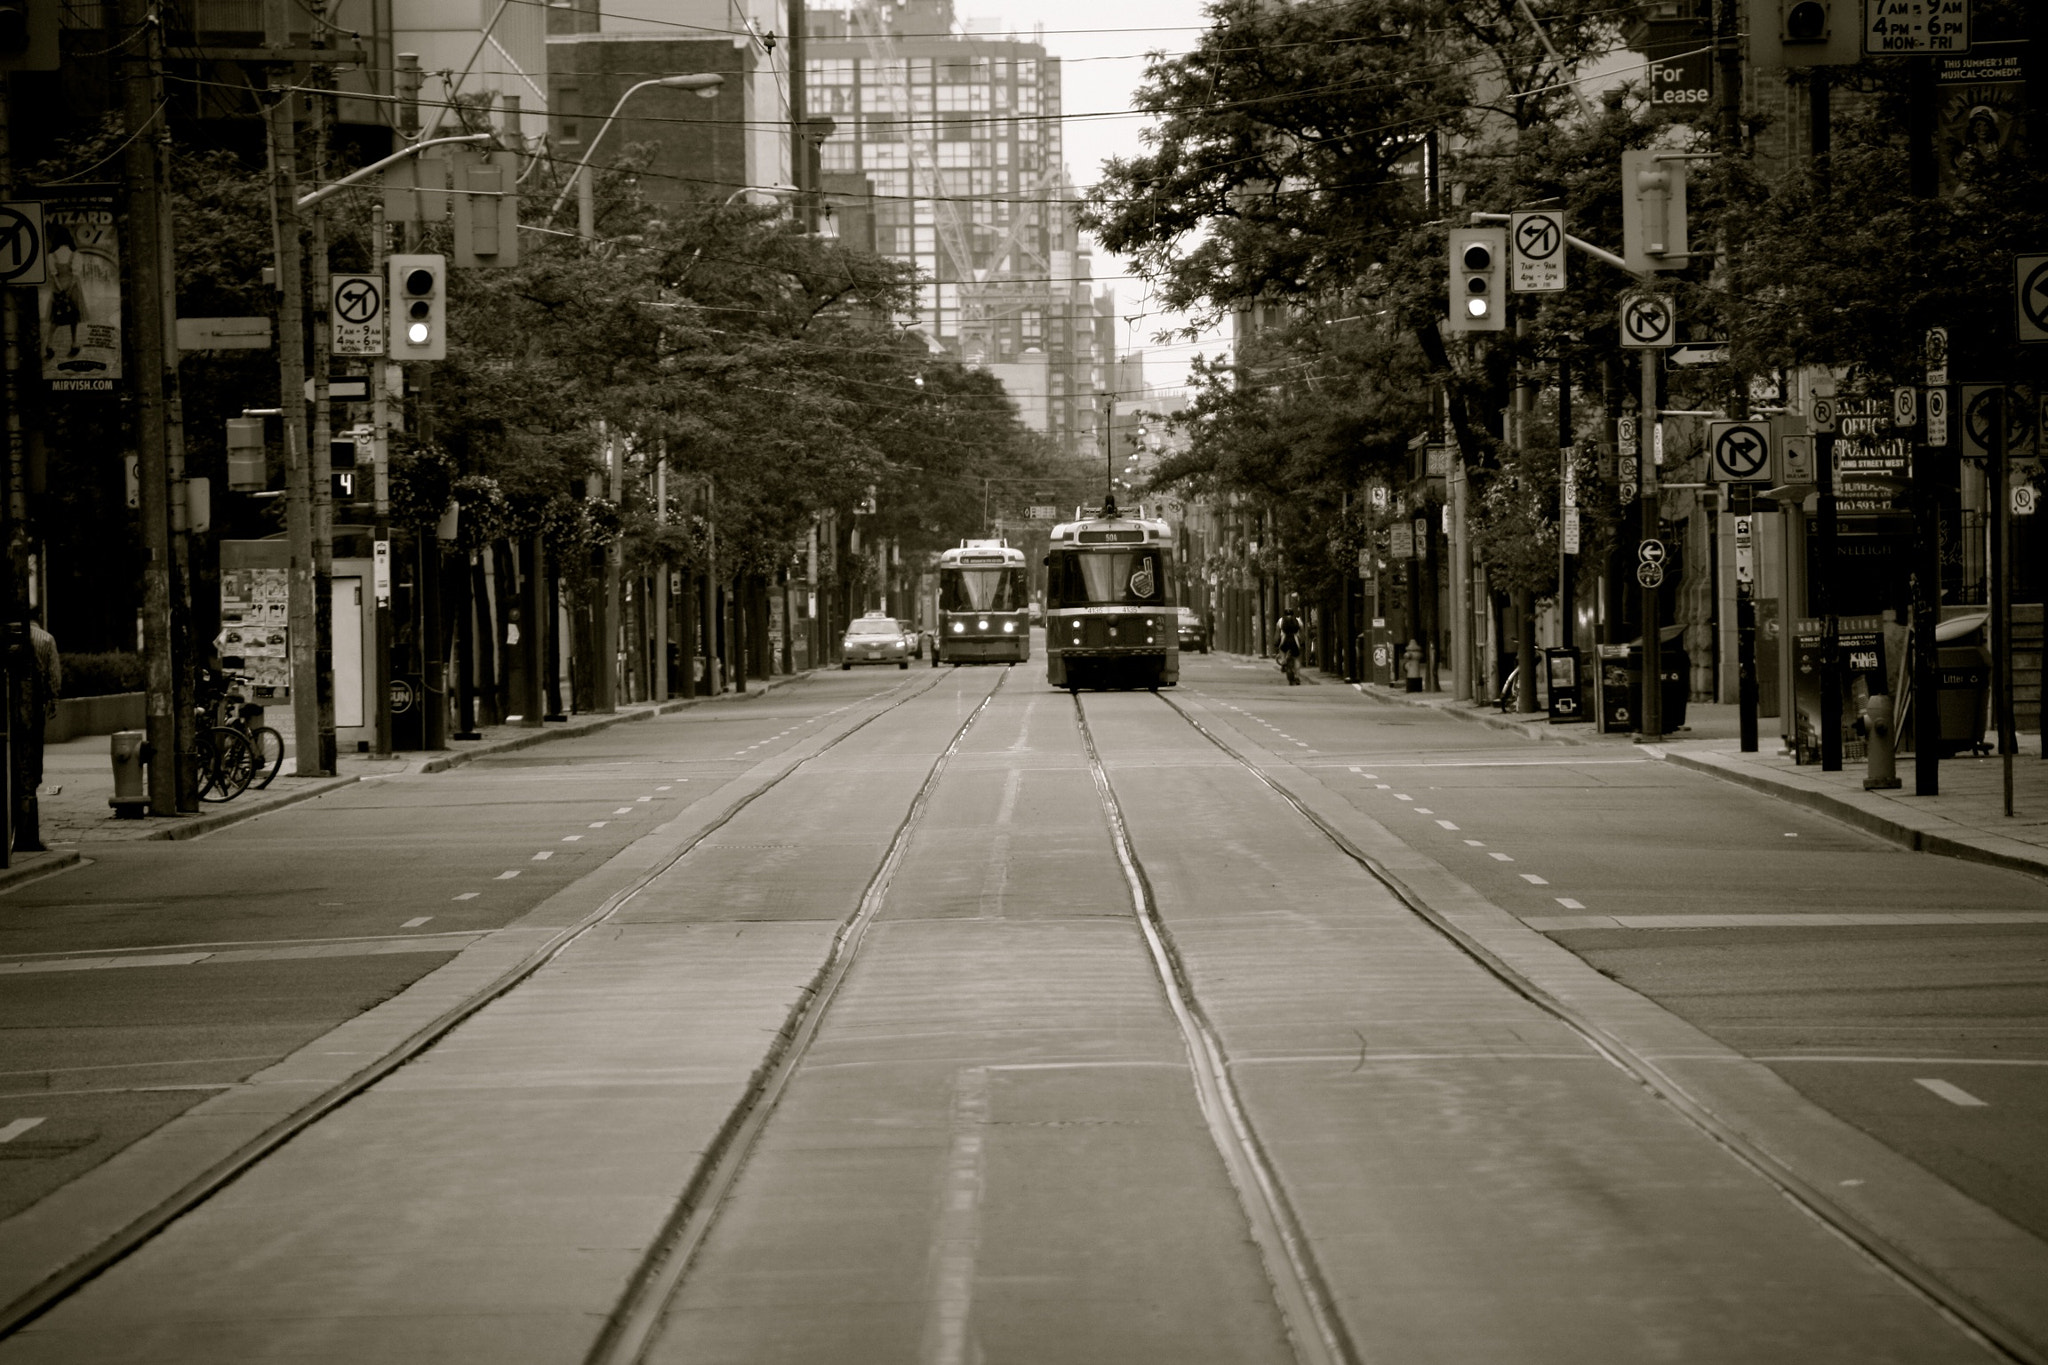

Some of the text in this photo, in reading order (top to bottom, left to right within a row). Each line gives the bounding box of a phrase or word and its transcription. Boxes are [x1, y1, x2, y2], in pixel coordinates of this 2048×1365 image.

[1873, 0, 1885, 15] 7
[1888, 4, 1908, 15] AM
[1942, 3, 1962, 14] AM
[1872, 17, 1888, 35] 4
[1891, 24, 1909, 35] PM
[1928, 15, 1941, 35] 6
[1944, 23, 1963, 34] PM
[1883, 37, 1914, 49] MON
[1930, 36, 1952, 49] FRI
[1944, 57, 2018, 69] THIS SUMMER'S HIT
[1651, 64, 1684, 82] For
[1651, 85, 1709, 104] Lease
[52, 380, 113, 391] MIRVISH.COM
[1858, 459, 1884, 468] STREET
[1885, 459, 1905, 468] WEST
[340, 473, 352, 495] 4
[1944, 674, 1964, 684] Litter
